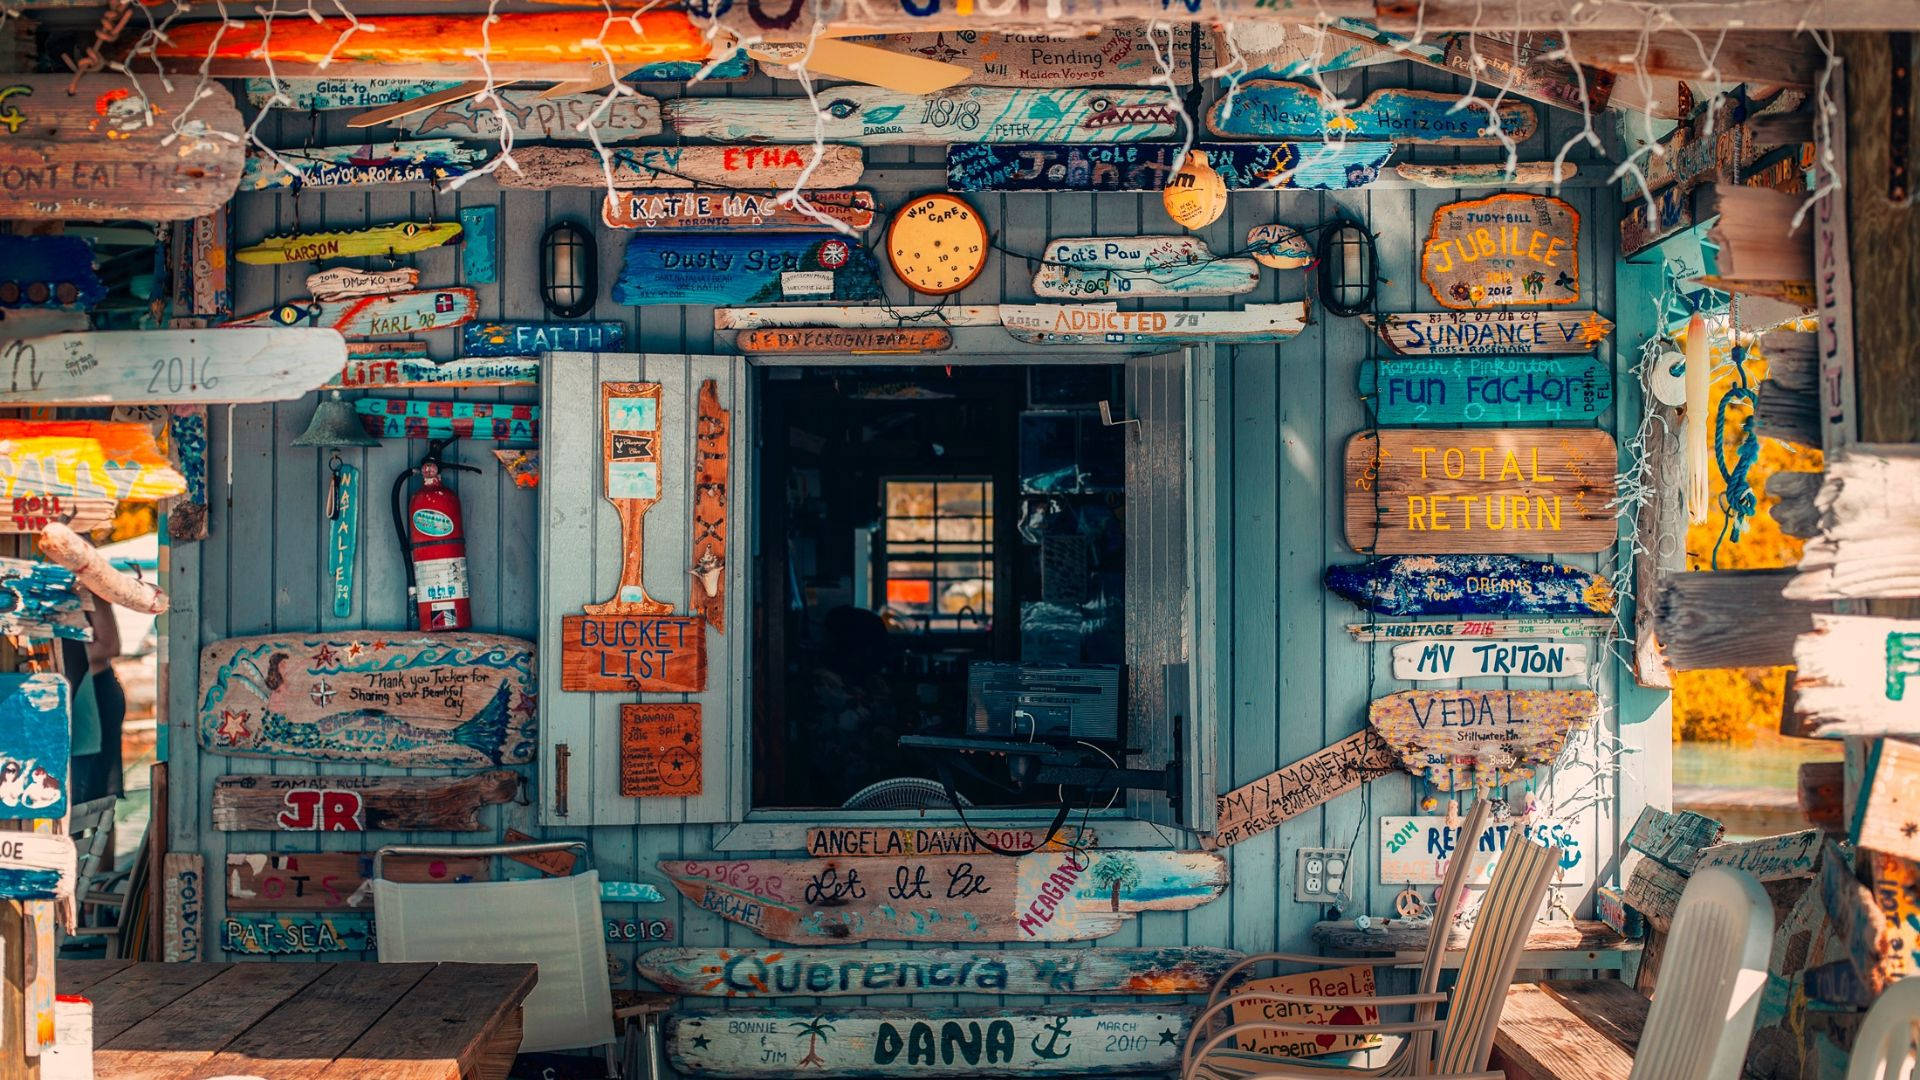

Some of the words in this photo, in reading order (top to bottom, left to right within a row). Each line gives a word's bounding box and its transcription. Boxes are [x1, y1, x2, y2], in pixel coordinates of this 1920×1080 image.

[1031, 48, 1102, 70] Pending
[1019, 68, 1060, 80] Maiden
[1061, 69, 1105, 82] Voyage
[316, 82, 347, 94] Glad
[352, 84, 367, 94] to
[340, 93, 355, 106] be
[536, 99, 649, 134] PISCES
[921, 96, 982, 131] 1818
[1261, 104, 1307, 125] New
[1377, 110, 1469, 134] Horizons
[995, 123, 1030, 137] PETER
[630, 192, 711, 219] KATIE
[804, 193, 850, 201] RCHARD
[907, 201, 935, 219] WHO
[928, 207, 968, 223] CARES
[678, 217, 730, 227] TORONTO
[284, 240, 340, 262] KARSON
[661, 247, 736, 271] Dusty
[745, 249, 801, 272] Sea
[938, 254, 949, 263] 10
[968, 244, 979, 254] 12
[1056, 245, 1098, 263] Cat's
[1104, 243, 1141, 260] Paw
[1434, 225, 1567, 273] JUBILEE
[320, 273, 340, 283] 2016
[1487, 286, 1513, 296] 2012
[370, 315, 412, 335] KARL
[1054, 309, 1167, 332] ADDICTED
[516, 326, 602, 351] FAITH
[1405, 319, 1548, 348] SUNDANCE
[1557, 321, 1580, 343] V
[147, 356, 220, 394] 2016
[1470, 357, 1567, 376] Pinkerton
[1389, 377, 1447, 406] Fun
[1467, 373, 1585, 407] Factor
[1597, 382, 1610, 399] FL
[1412, 447, 1555, 483] TOTAL
[696, 415, 726, 545] ALEX
[12, 496, 64, 514] ROLL
[1407, 495, 1562, 531] RETURN
[335, 472, 351, 581] NATALIE
[1466, 576, 1533, 594] DREAMS
[580, 619, 691, 647] BUCKET
[1385, 624, 1454, 637] HERITAGE
[1460, 621, 1497, 637] 2016
[600, 649, 674, 679] LIST
[1416, 643, 1455, 674] MV
[1472, 642, 1565, 674] TRITON
[364, 671, 405, 689] Thank
[409, 676, 430, 690] you
[430, 668, 469, 685] Tucker
[471, 667, 490, 682] for
[349, 687, 390, 707] Sharing
[395, 688, 419, 705] your
[444, 697, 464, 718] Cay
[1408, 693, 1496, 729] VEDA
[1506, 694, 1531, 725] L.
[1427, 753, 1447, 765] Bob
[276, 788, 363, 831] JR
[812, 830, 902, 855] ANGELA
[916, 830, 978, 854] DAWN
[986, 831, 1036, 850] 2012
[1385, 820, 1420, 854] 2014
[804, 867, 866, 905] Let
[888, 865, 933, 899] It
[946, 862, 991, 899] Be
[1017, 854, 1085, 938] MEAGAN
[227, 920, 336, 947] PAT-SEA
[728, 1021, 778, 1034] BONNIE
[1096, 1020, 1137, 1032] MARCH
[873, 1020, 1015, 1067] DANA
[1106, 1034, 1148, 1054] 2010
[760, 1048, 788, 1064] JIM
